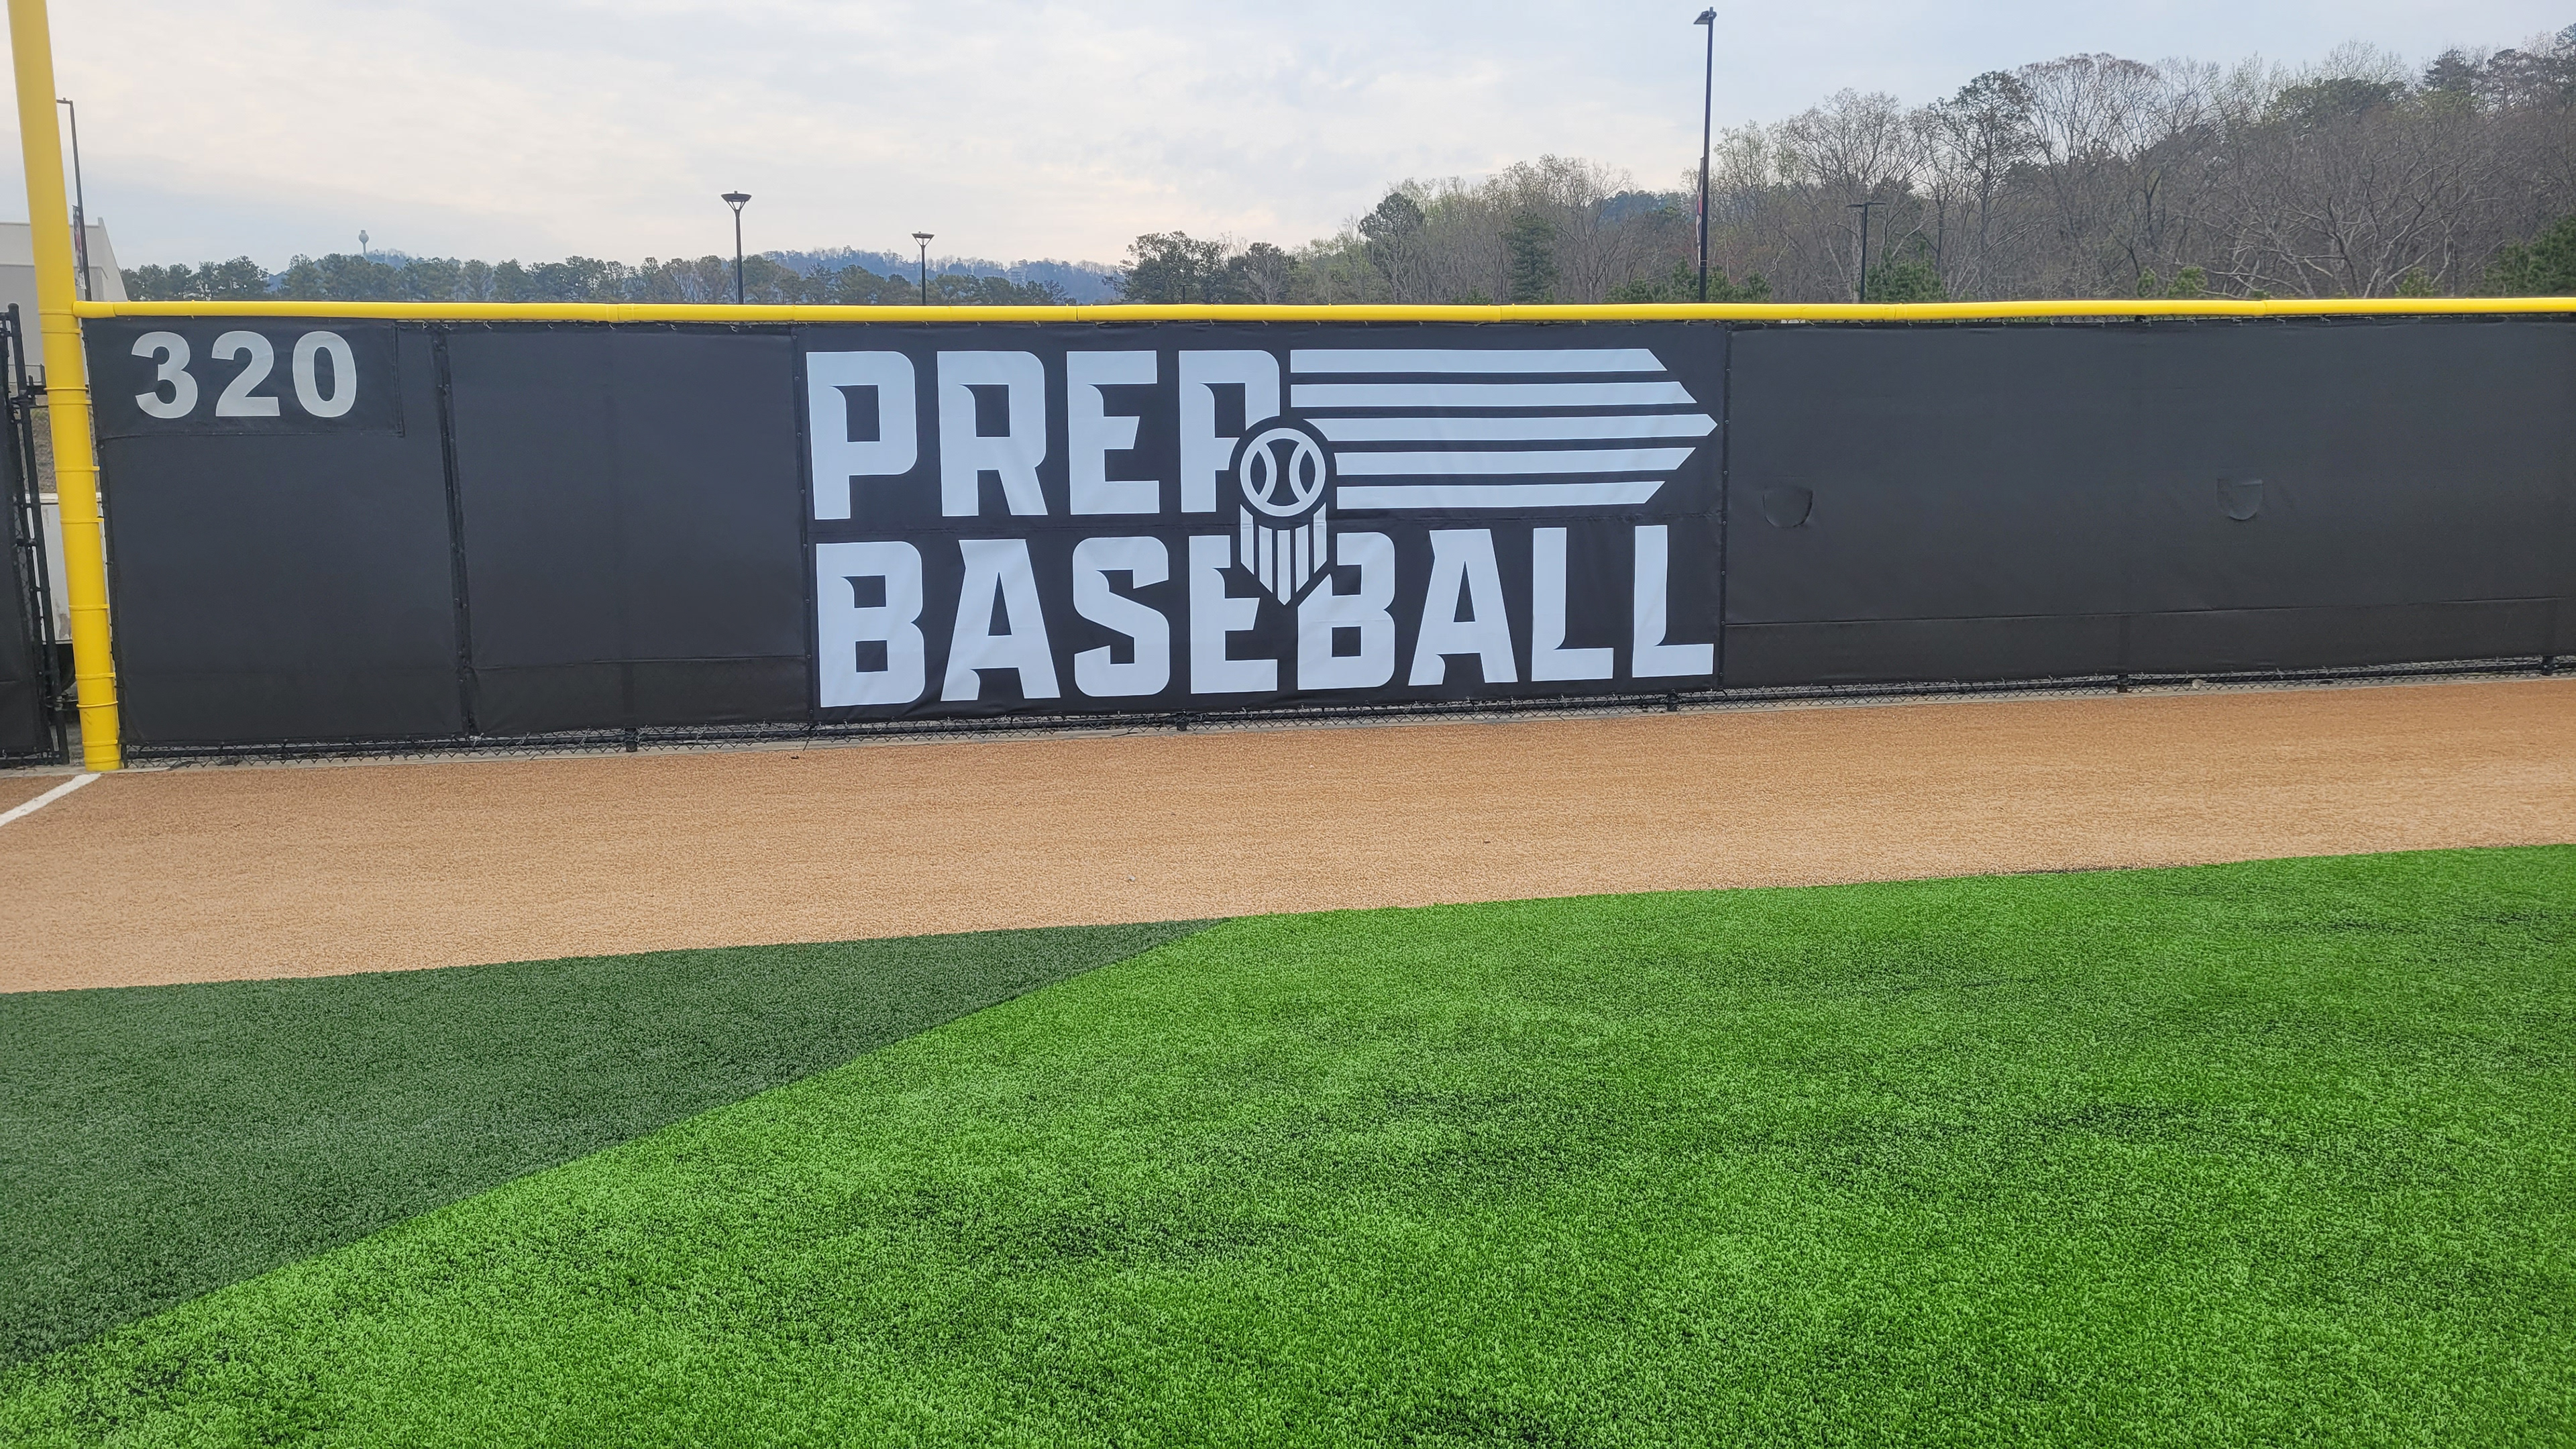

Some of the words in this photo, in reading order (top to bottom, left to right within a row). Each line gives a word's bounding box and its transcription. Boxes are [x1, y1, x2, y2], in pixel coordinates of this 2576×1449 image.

[131, 331, 357, 419] 320
[806, 350, 1281, 519] PREP
[816, 525, 1714, 708] BASEBALL
